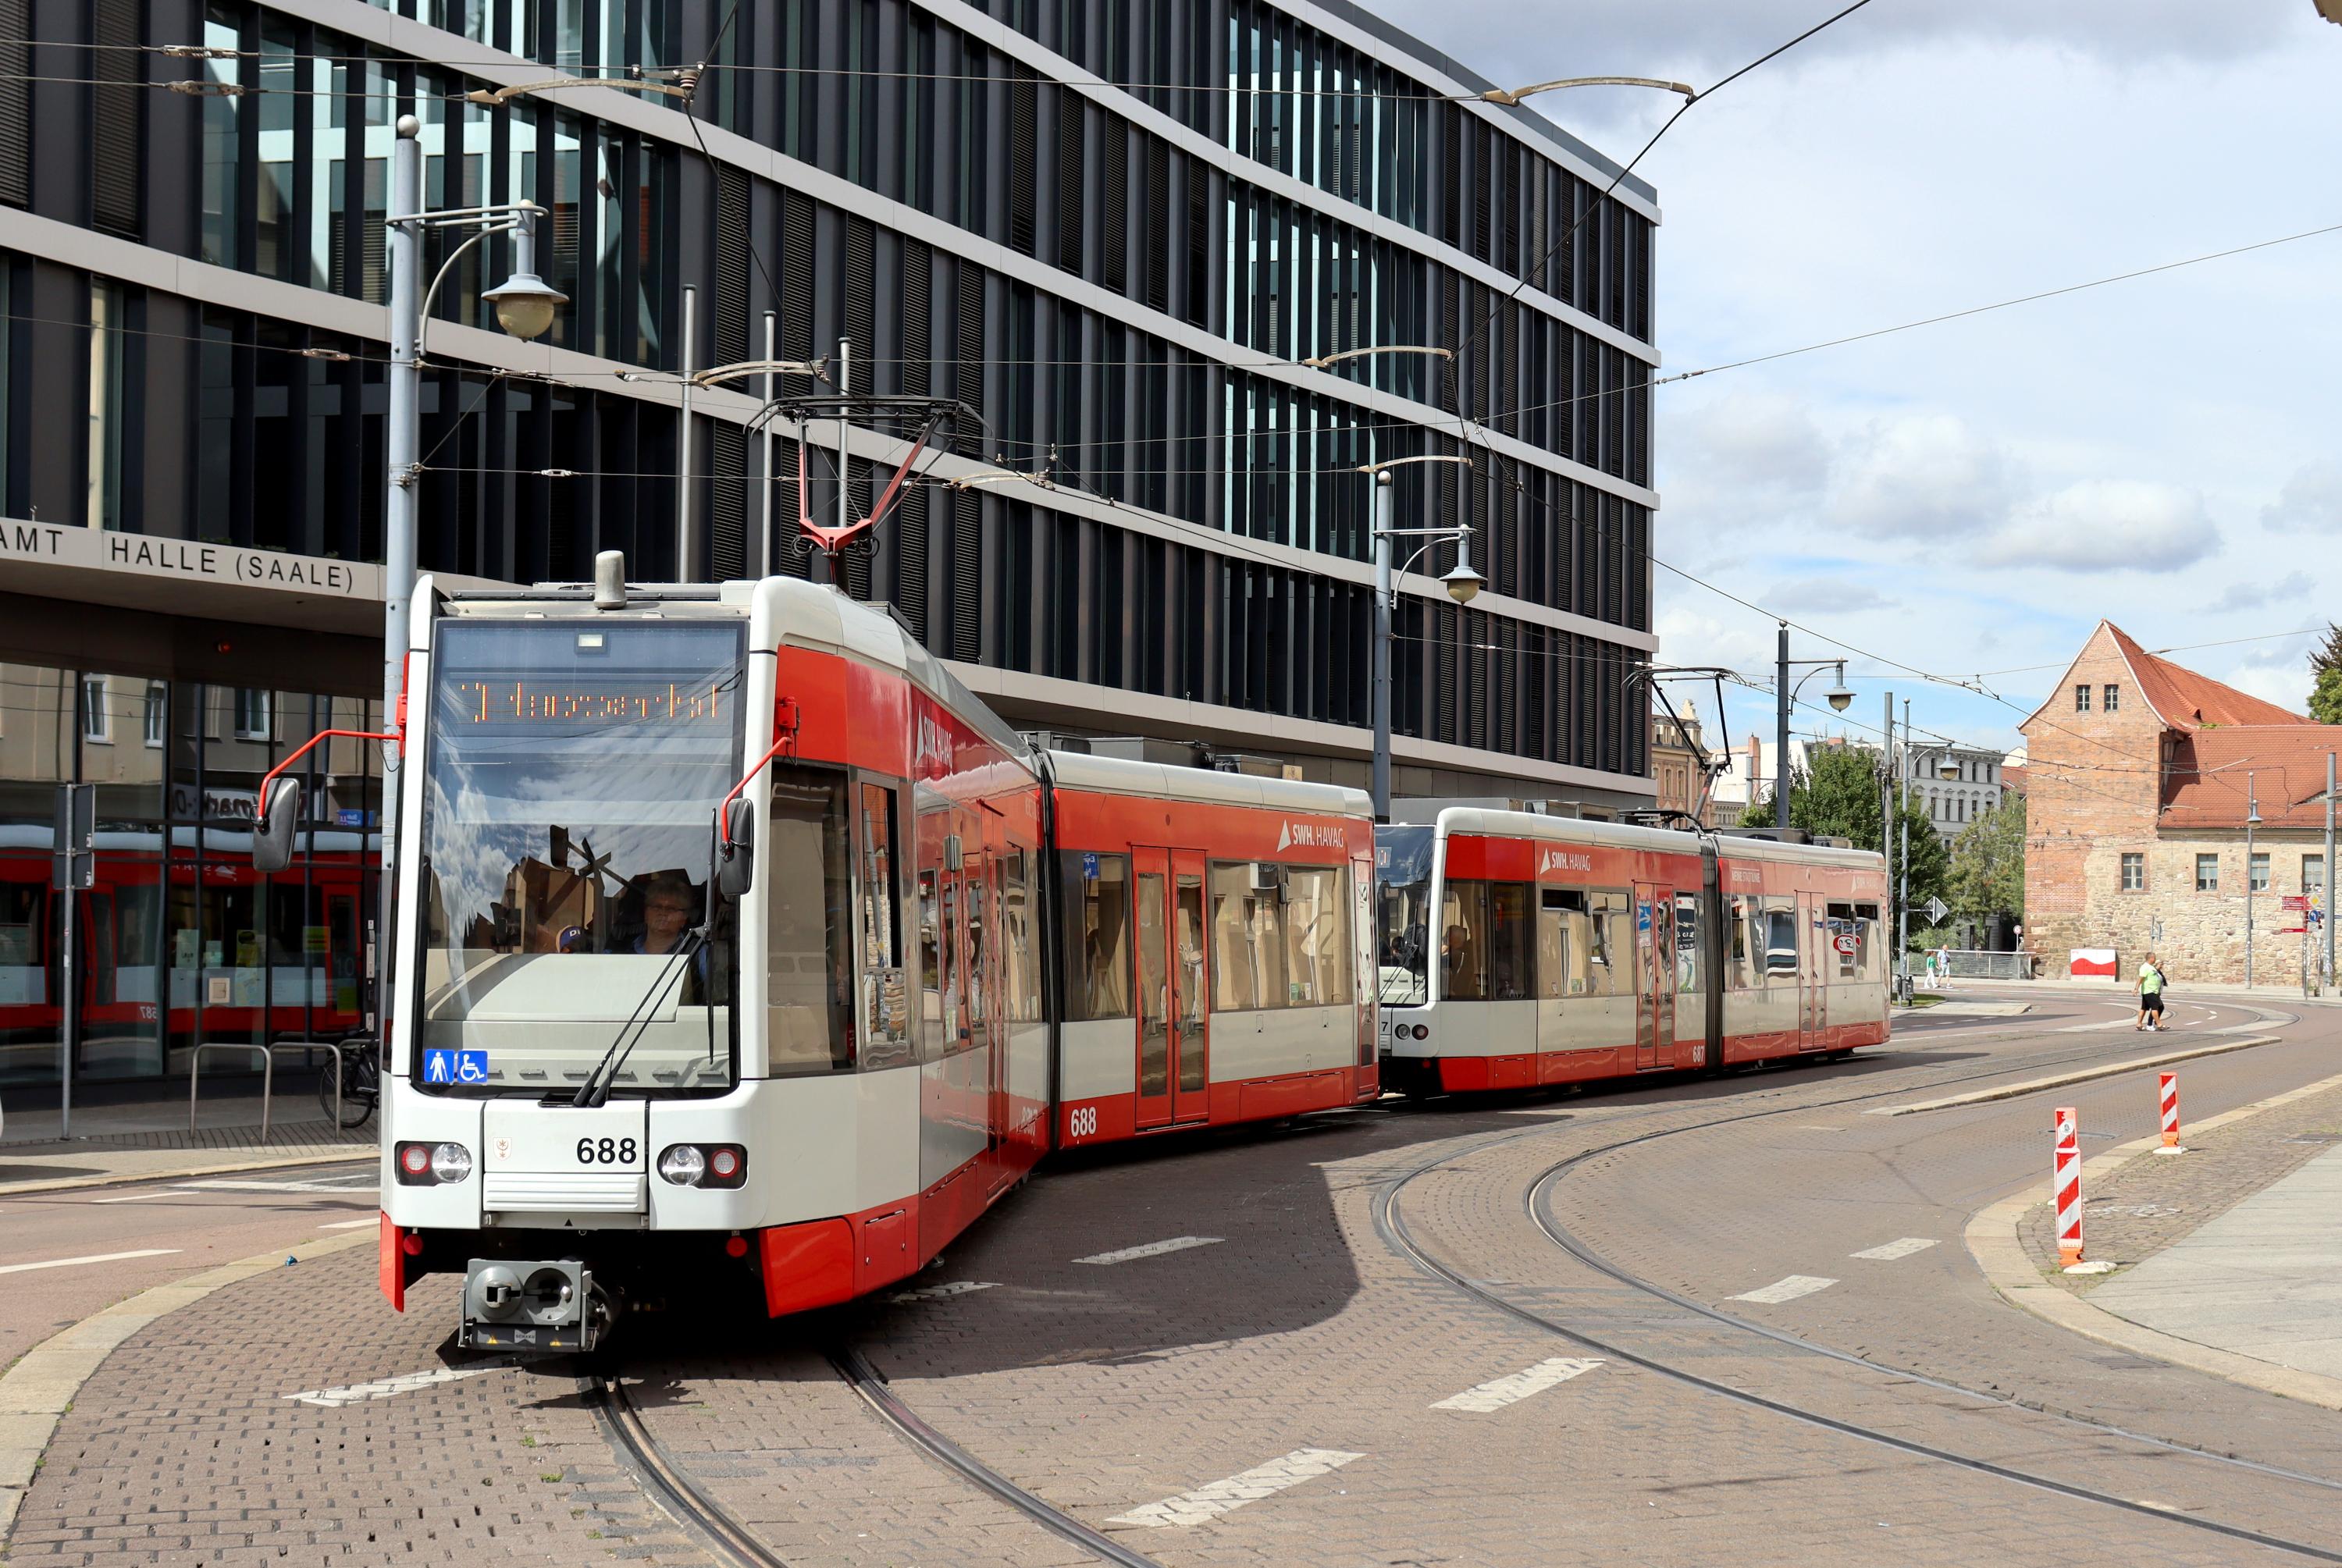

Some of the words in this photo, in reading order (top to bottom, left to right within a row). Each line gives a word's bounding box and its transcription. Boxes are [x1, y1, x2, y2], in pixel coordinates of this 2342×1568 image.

[112, 537, 216, 574] HALLE
[236, 553, 353, 593] (SAALE)
[1293, 823, 1315, 846] SWH.
[1316, 826, 1344, 848] HAVAG
[1551, 851, 1568, 870] SWH.
[1569, 854, 1591, 872] HAVAG
[1692, 1045, 1705, 1063] 687
[1071, 1107, 1097, 1137] 688
[577, 1137, 637, 1164] 688
